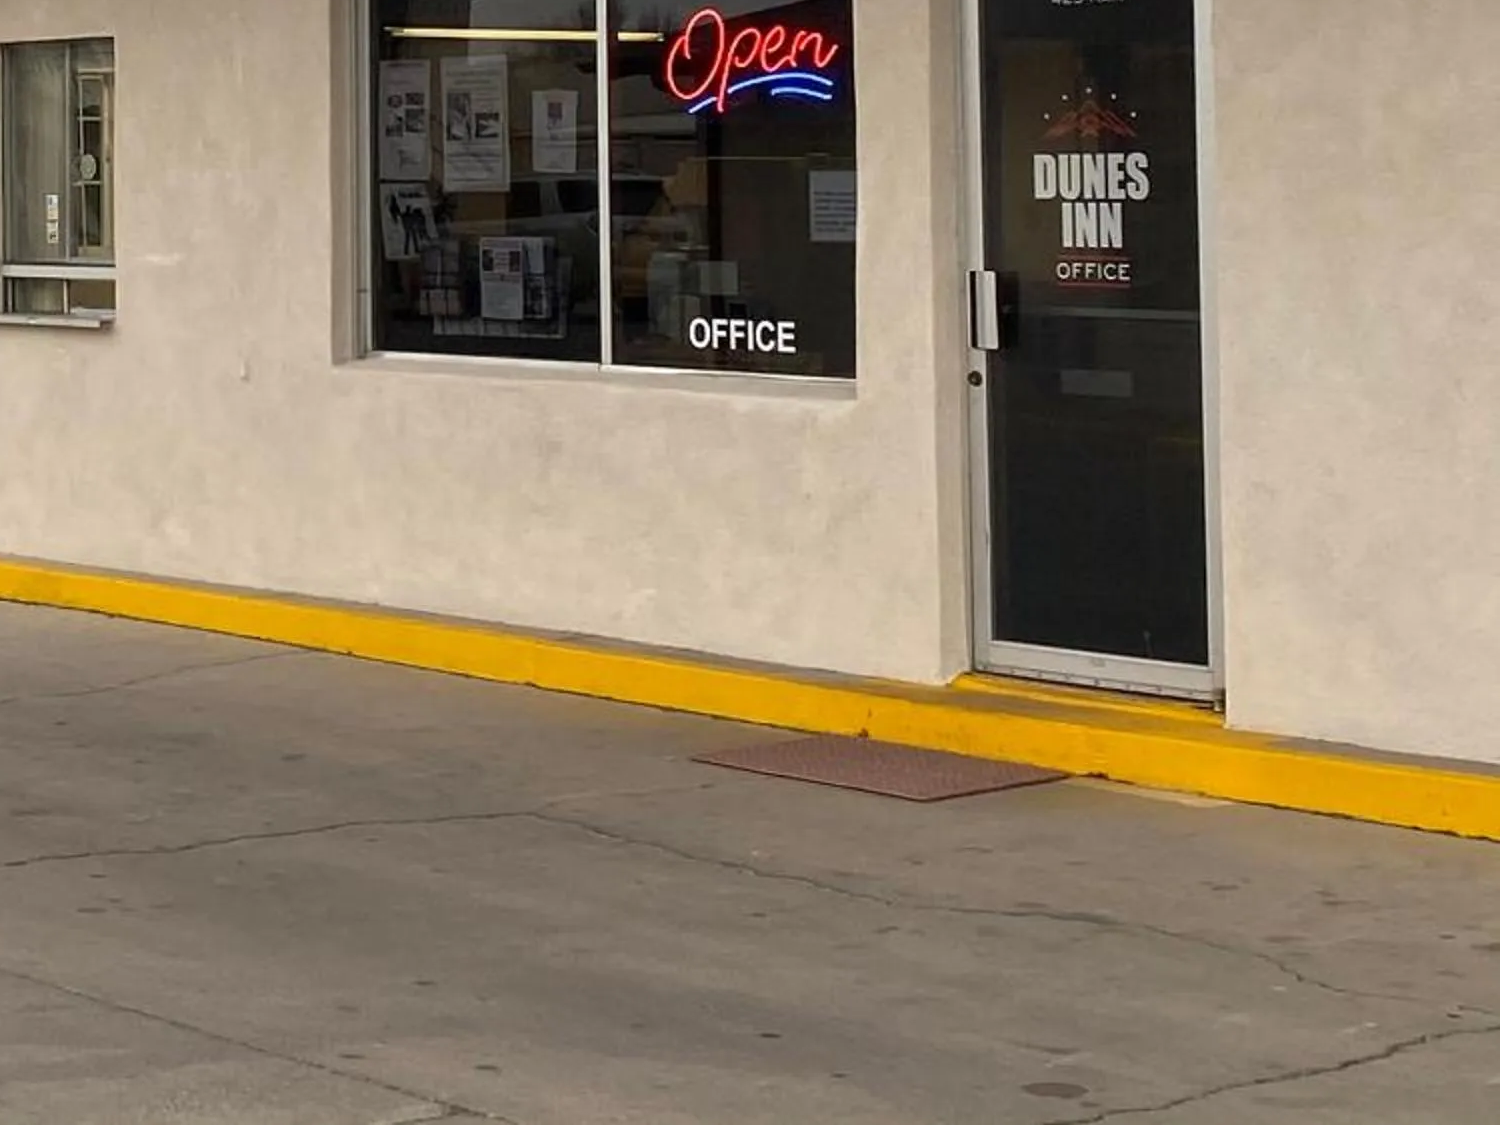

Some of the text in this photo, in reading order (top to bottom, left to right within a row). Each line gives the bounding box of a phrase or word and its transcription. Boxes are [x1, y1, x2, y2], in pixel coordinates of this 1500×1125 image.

[667, 8, 838, 114] Open
[1033, 152, 1150, 200] DUNES
[1061, 202, 1123, 249] INN
[1056, 263, 1131, 282] OFFICE
[688, 318, 797, 353] OFFICE
